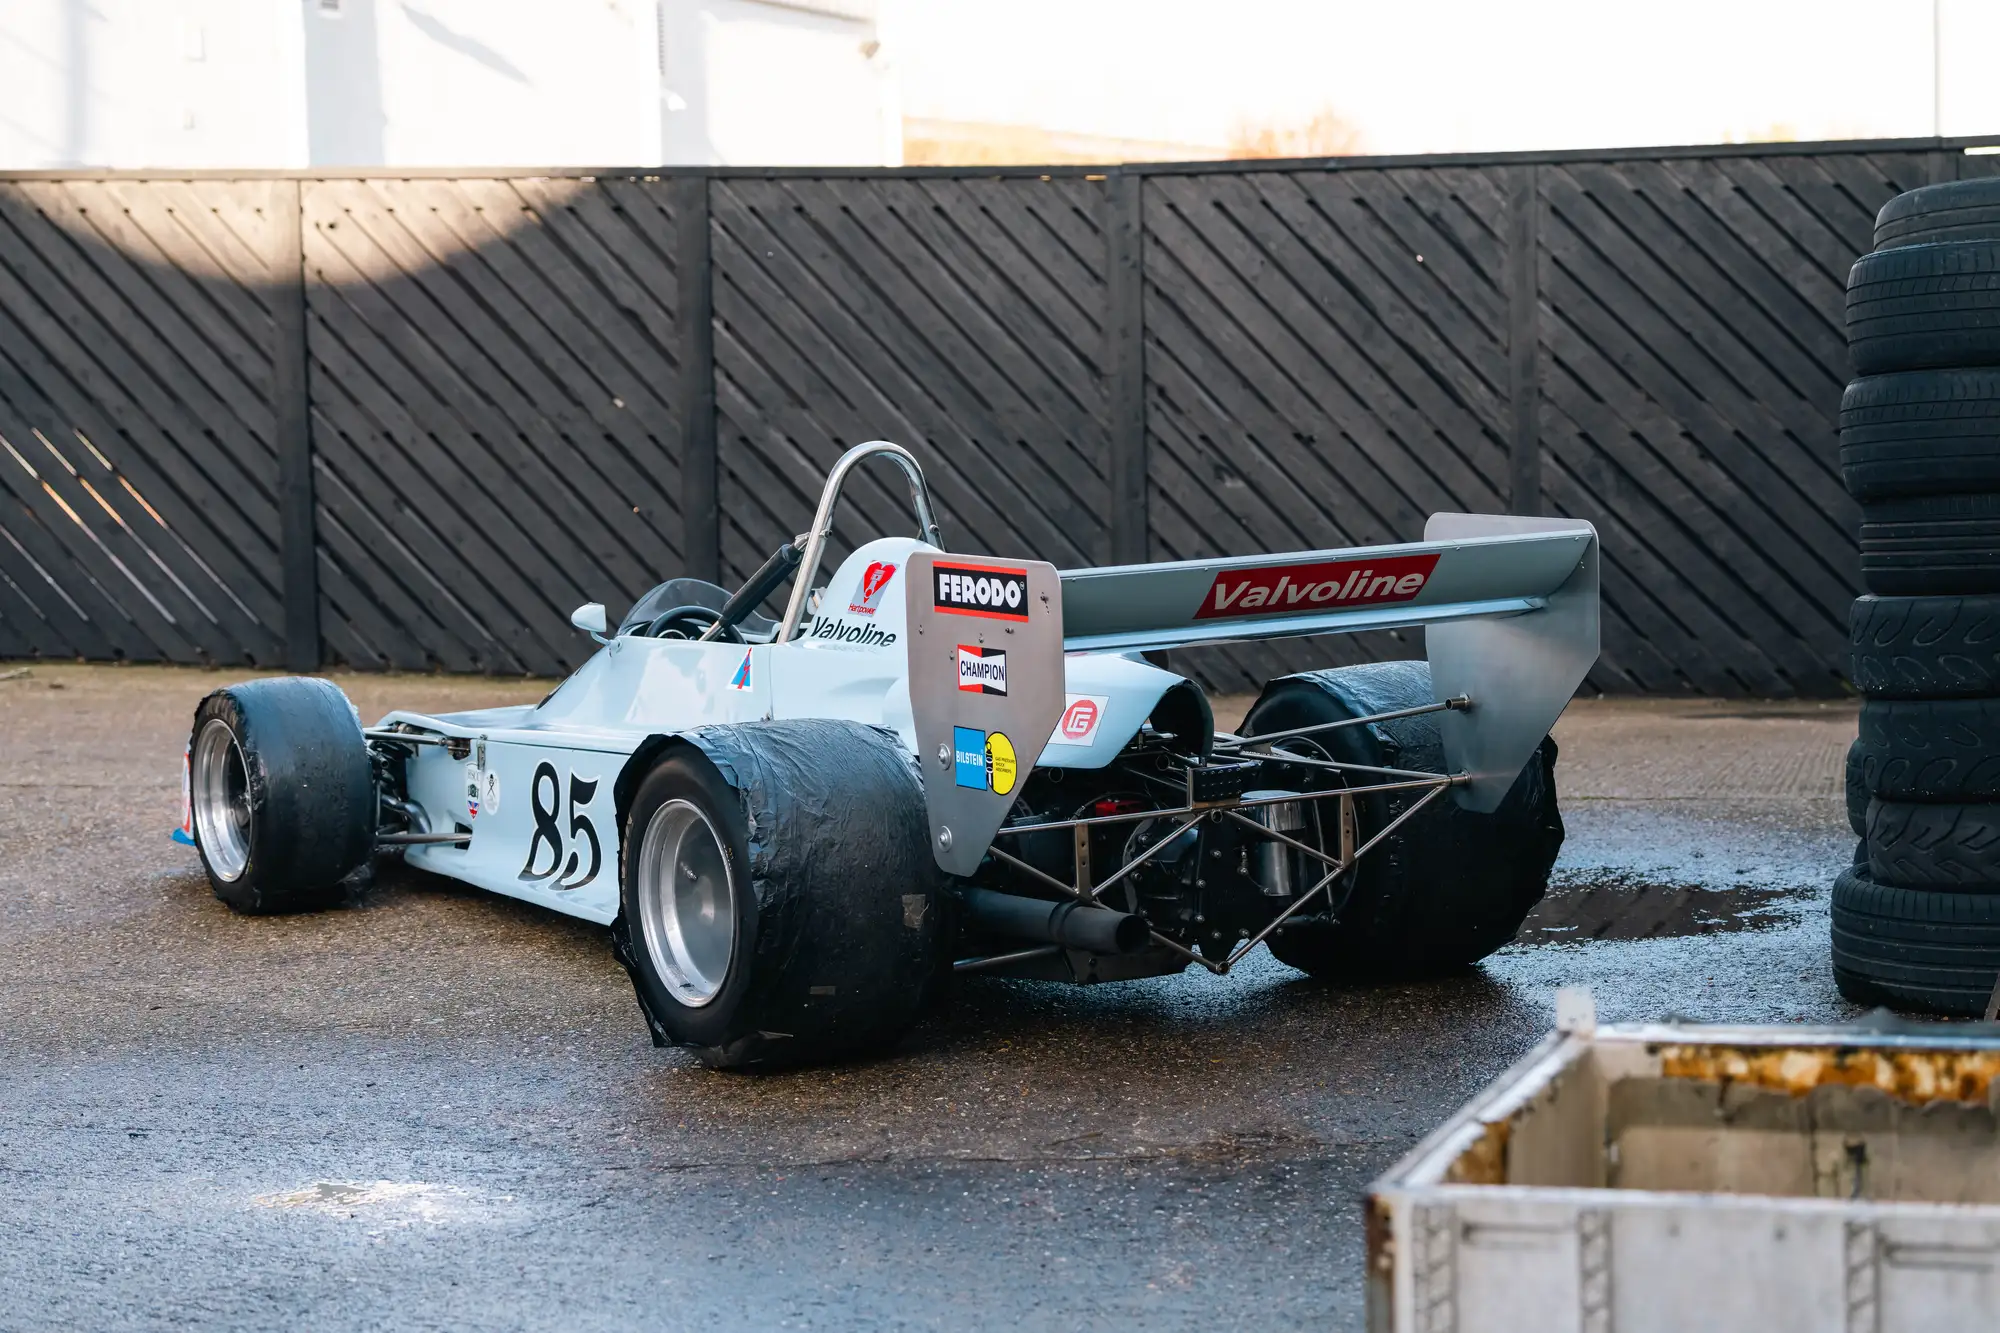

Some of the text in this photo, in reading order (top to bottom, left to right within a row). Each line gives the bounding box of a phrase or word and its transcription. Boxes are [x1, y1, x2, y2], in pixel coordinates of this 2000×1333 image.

[939, 573, 1021, 608] FERODO
[1214, 570, 1425, 610] Valvoline
[811, 616, 897, 647] Valvoline
[960, 660, 1005, 681] CHAMPION
[956, 750, 984, 767] BILSTEIN
[517, 760, 601, 891] 85
